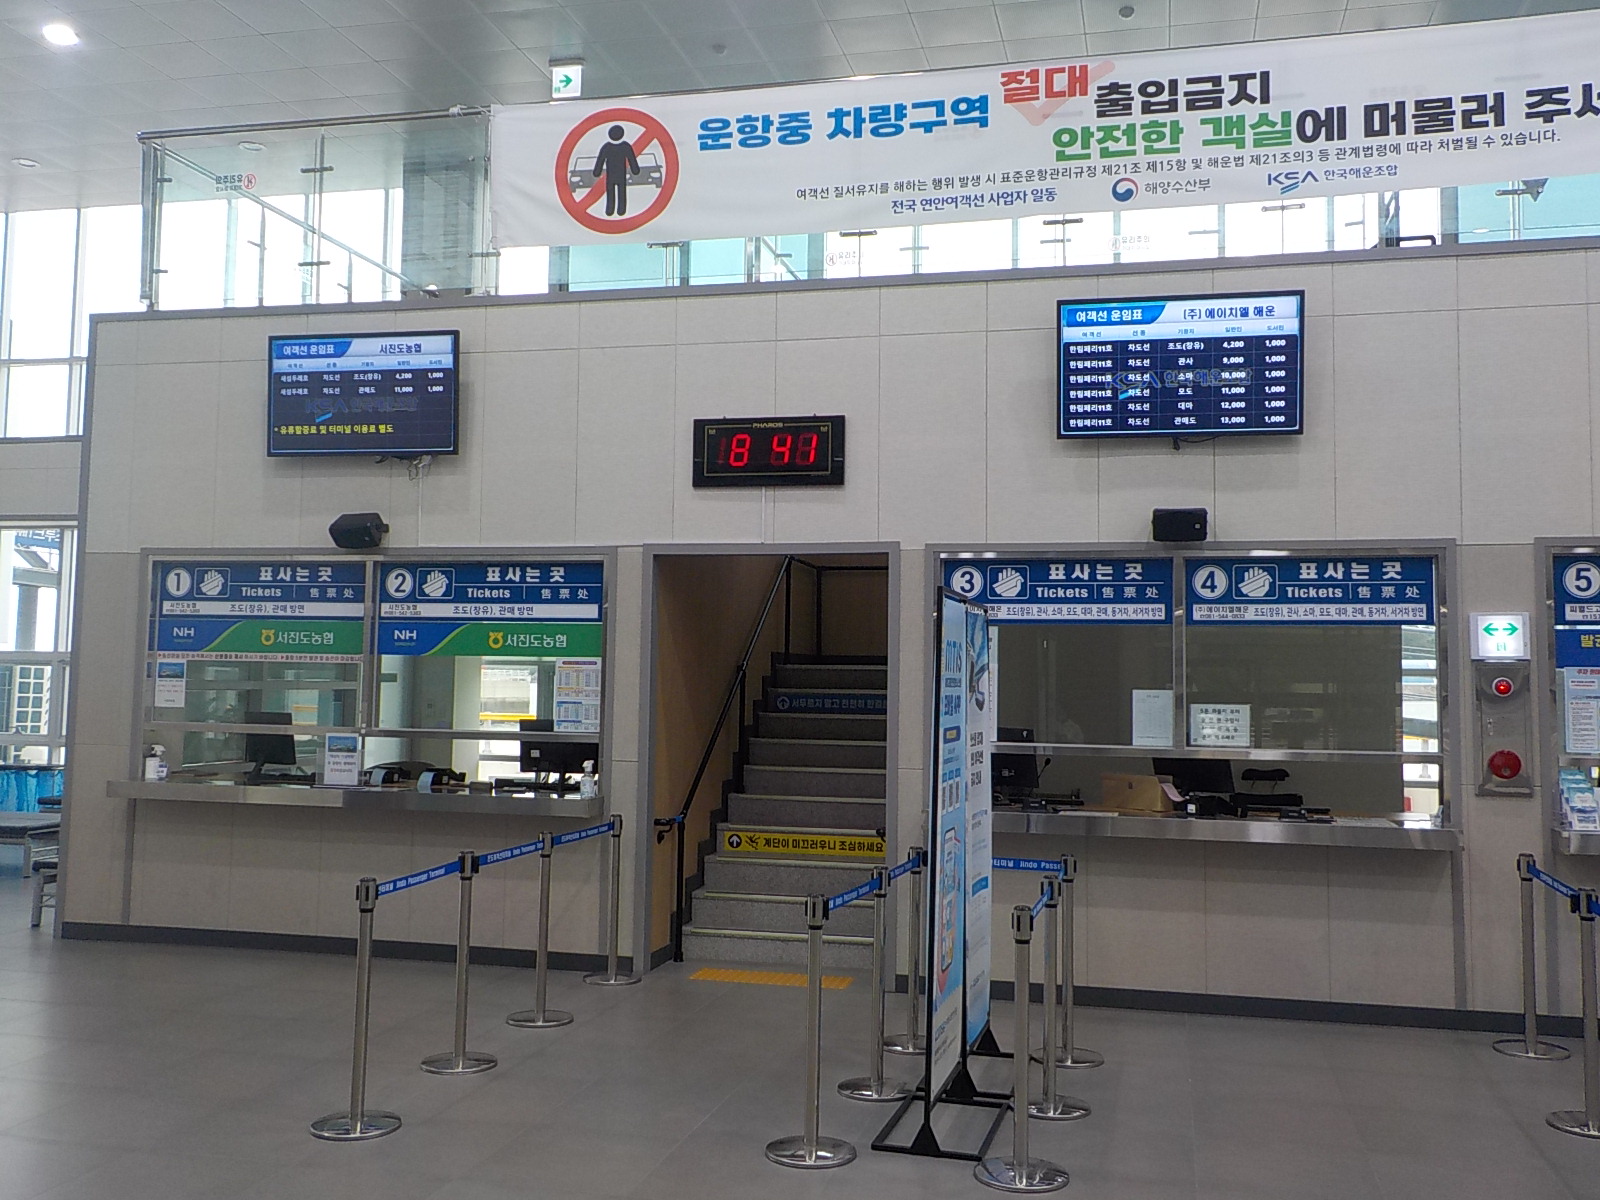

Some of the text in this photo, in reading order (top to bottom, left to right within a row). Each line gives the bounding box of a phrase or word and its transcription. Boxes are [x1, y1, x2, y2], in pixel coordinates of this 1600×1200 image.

[1000, 64, 1271, 118] 절대 출입금지
[697, 94, 990, 151] 운항중 차량구역
[1052, 117, 1183, 162] 안전한
[1200, 107, 1348, 150] 객실에
[1363, 91, 1505, 139] 머물러
[796, 129, 1561, 200] 여객선 질서유지를 해하는 행위 발생 시 표준운항관리규정 제21조 제15항 및 해운법 제21조의3 등 관계법령에 따라 처벌될 수 있습니다.
[1324, 164, 1398, 181] 한국해운조합
[1144, 178, 1211, 194] 해양수산부
[1268, 171, 1319, 190] KSA
[890, 187, 1058, 214] 전국 연안여객선 사업자 일동
[1076, 309, 1143, 322] 여객선 운임표
[1183, 306, 1276, 320] (주) 에이치엘 해운
[283, 344, 335, 356] 여객선 운임표
[379, 343, 422, 354] 서진도농협
[1222, 340, 1245, 348] 4,200
[1265, 339, 1286, 347] 1,000
[1222, 356, 1245, 364] 9,000
[1265, 355, 1286, 363] 1,000
[1265, 370, 1286, 378] 1,000
[1221, 386, 1246, 394] 11,000
[1178, 402, 1194, 410] 대마
[1221, 401, 1246, 409] 12,000
[1265, 400, 1286, 408] 1,000
[1221, 416, 1246, 424] 13,000
[1265, 415, 1286, 423] 1,000
[729, 433, 818, 467] 8 41
[259, 566, 333, 582] 표사는 곳
[486, 566, 565, 583] 표사는 곳
[1049, 563, 1143, 580] 표사는 곳
[1299, 562, 1402, 579] 표사는 곳
[174, 573, 181, 591] 1
[393, 572, 407, 593] 2
[960, 571, 974, 594] 3
[1201, 571, 1217, 593] 4
[1574, 568, 1592, 592] 5
[241, 586, 282, 597] Tickets
[467, 588, 511, 598] Tickets
[1036, 586, 1089, 598] Tickets
[1285, 586, 1343, 598] Tickets
[229, 604, 305, 614] 조도(창유), 관매 방면
[452, 606, 534, 616] 조도(창유), 관매 방면
[1006, 606, 1035, 617] 조도(창유),
[1036, 607, 1050, 617] 관사,
[1051, 607, 1065, 617] 소마,
[1081, 607, 1095, 617] 대마,
[1096, 607, 1110, 617] 관매,
[1111, 607, 1131, 618] 동거차,
[1132, 607, 1150, 618] 서거차
[1151, 607, 1163, 618] 방면
[1254, 607, 1424, 618] 조도(창유), 관사, 소마, 모도, 대마, 관매, 동거차, 서거차 방면
[173, 627, 195, 636] NH
[394, 630, 417, 640] NH
[276, 632, 334, 645] 서진도농협
[505, 634, 567, 648] 서진도농협
[763, 836, 884, 852] 계단이 미끄러우니 조심하세요
[1020, 860, 1037, 868] Jindo
